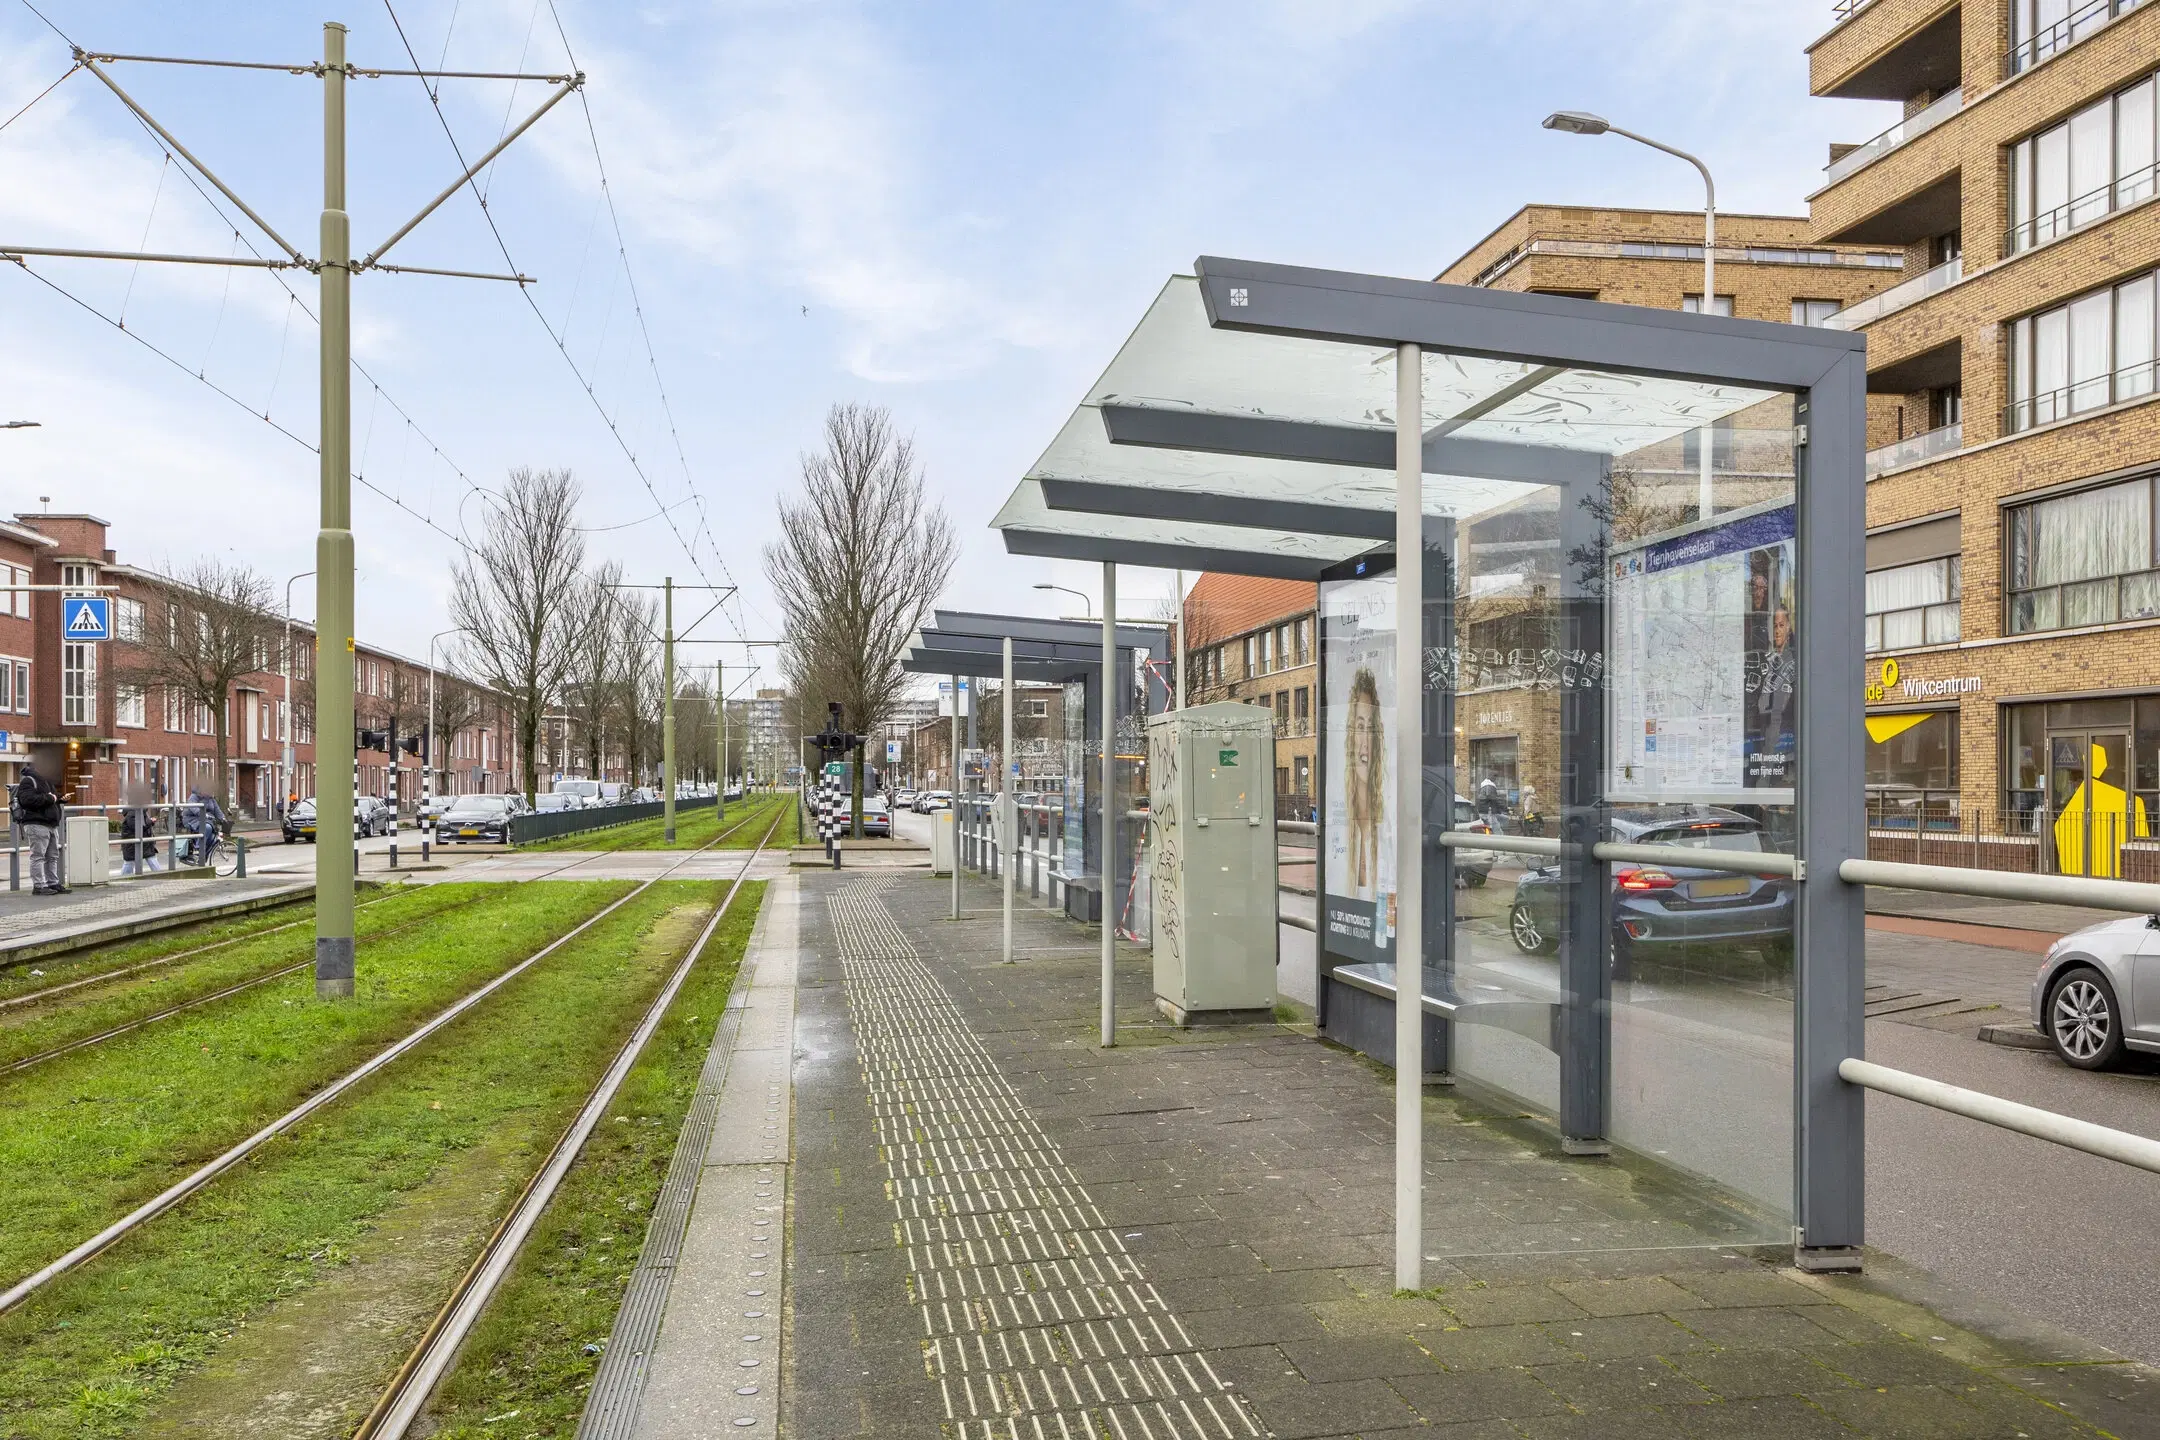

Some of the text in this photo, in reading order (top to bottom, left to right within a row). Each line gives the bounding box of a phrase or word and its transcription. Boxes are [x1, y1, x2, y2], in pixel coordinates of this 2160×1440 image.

[1903, 676, 1981, 701] Wijkcentrum
[1779, 752, 1786, 764] je
[831, 765, 841, 773] 28
[1750, 768, 1760, 776] een
